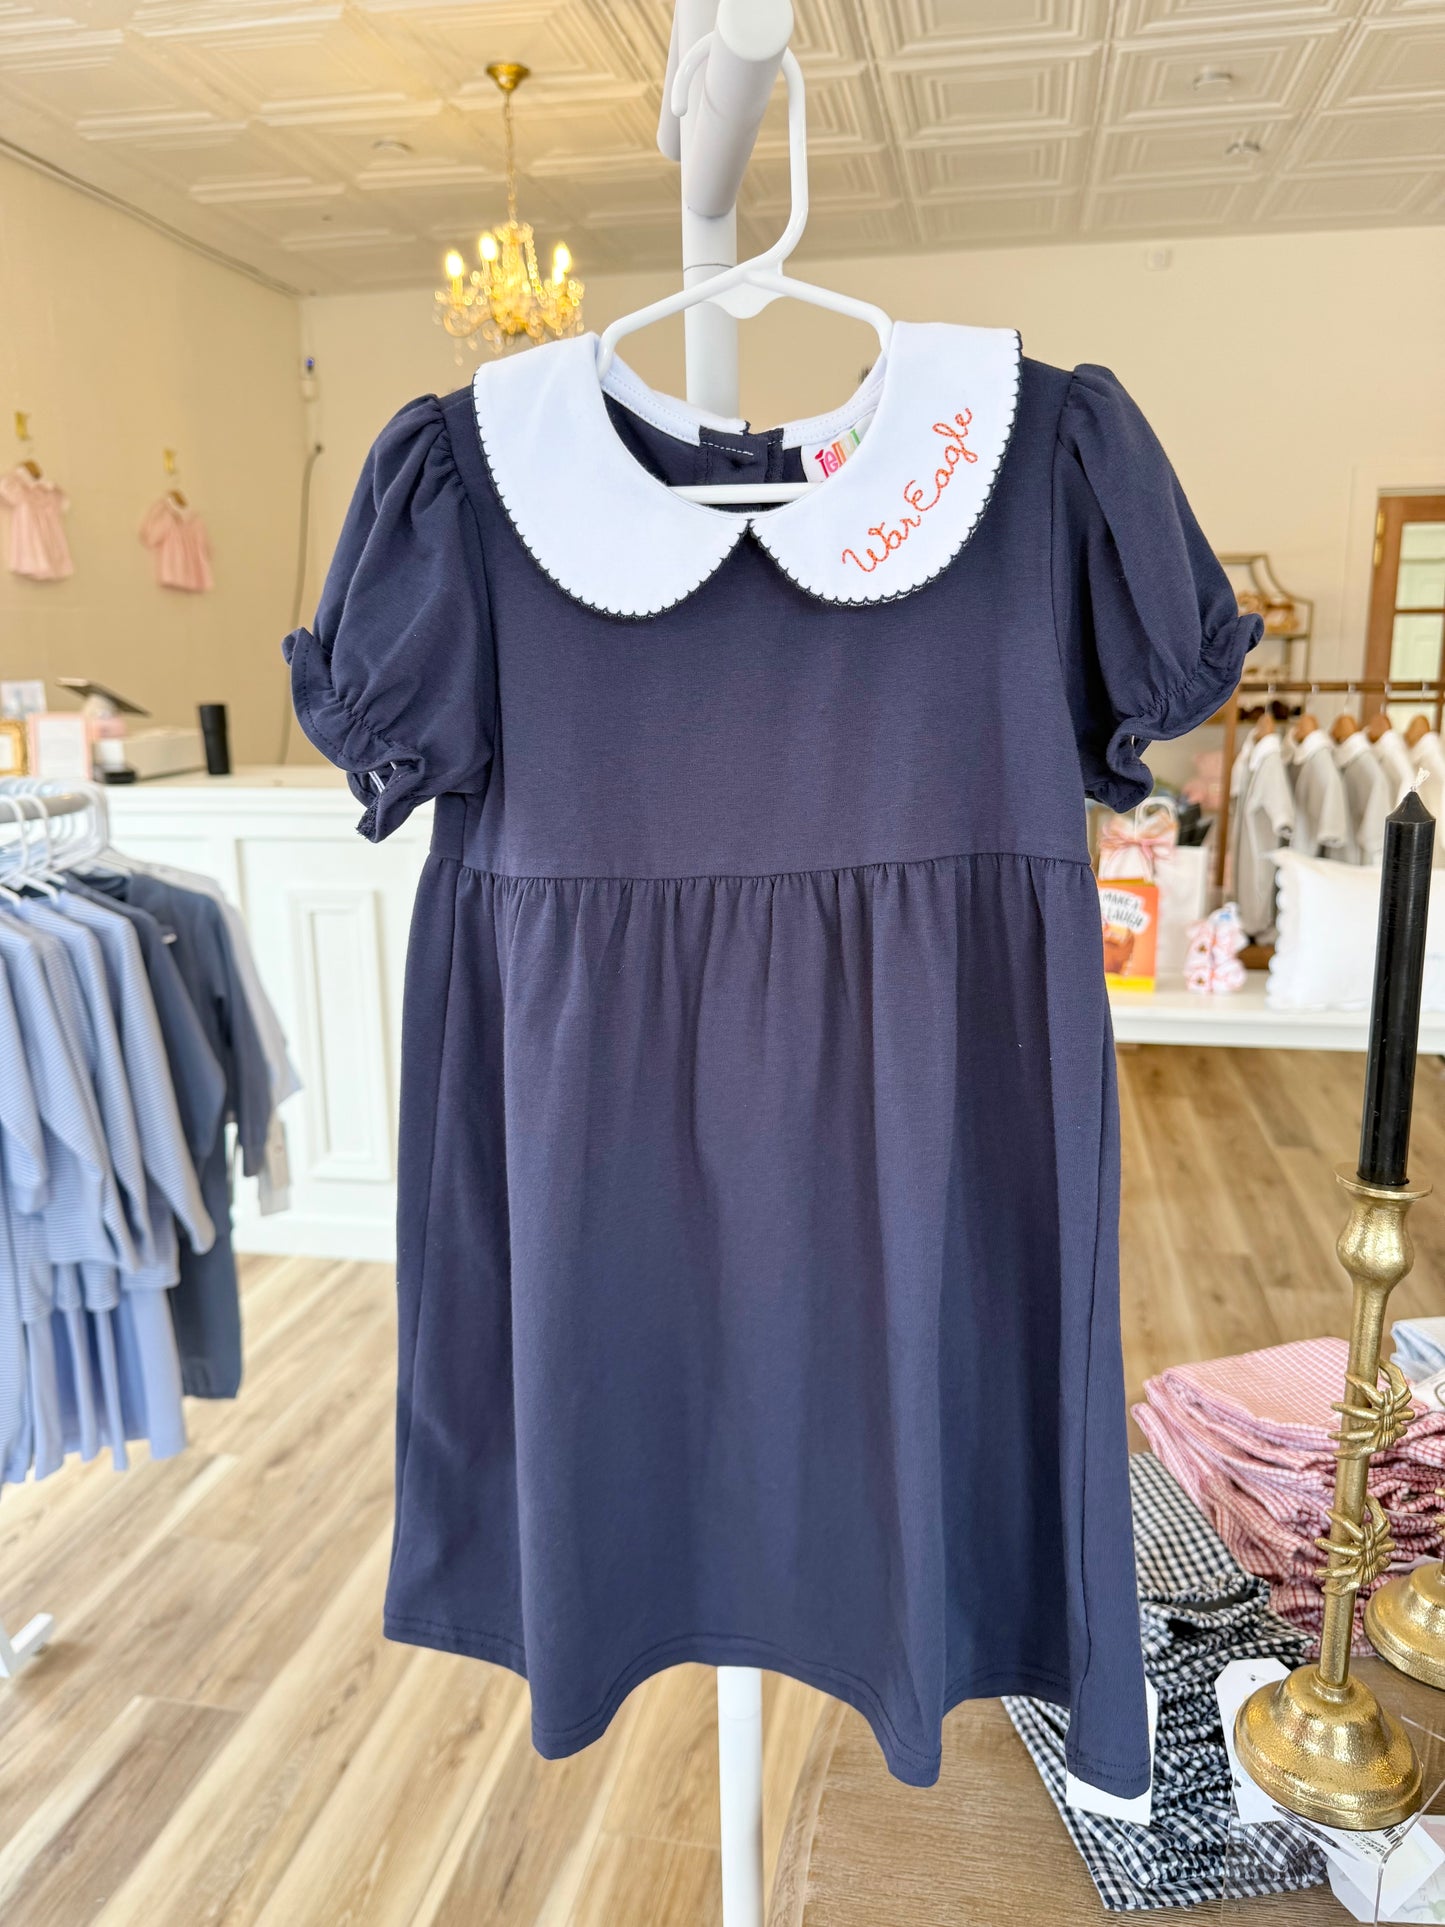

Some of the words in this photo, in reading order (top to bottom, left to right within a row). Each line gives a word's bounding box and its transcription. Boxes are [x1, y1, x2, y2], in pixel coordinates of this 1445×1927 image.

[841, 515, 921, 573] War
[903, 407, 979, 512] Eagle
[1107, 906, 1144, 928] LAUGH
